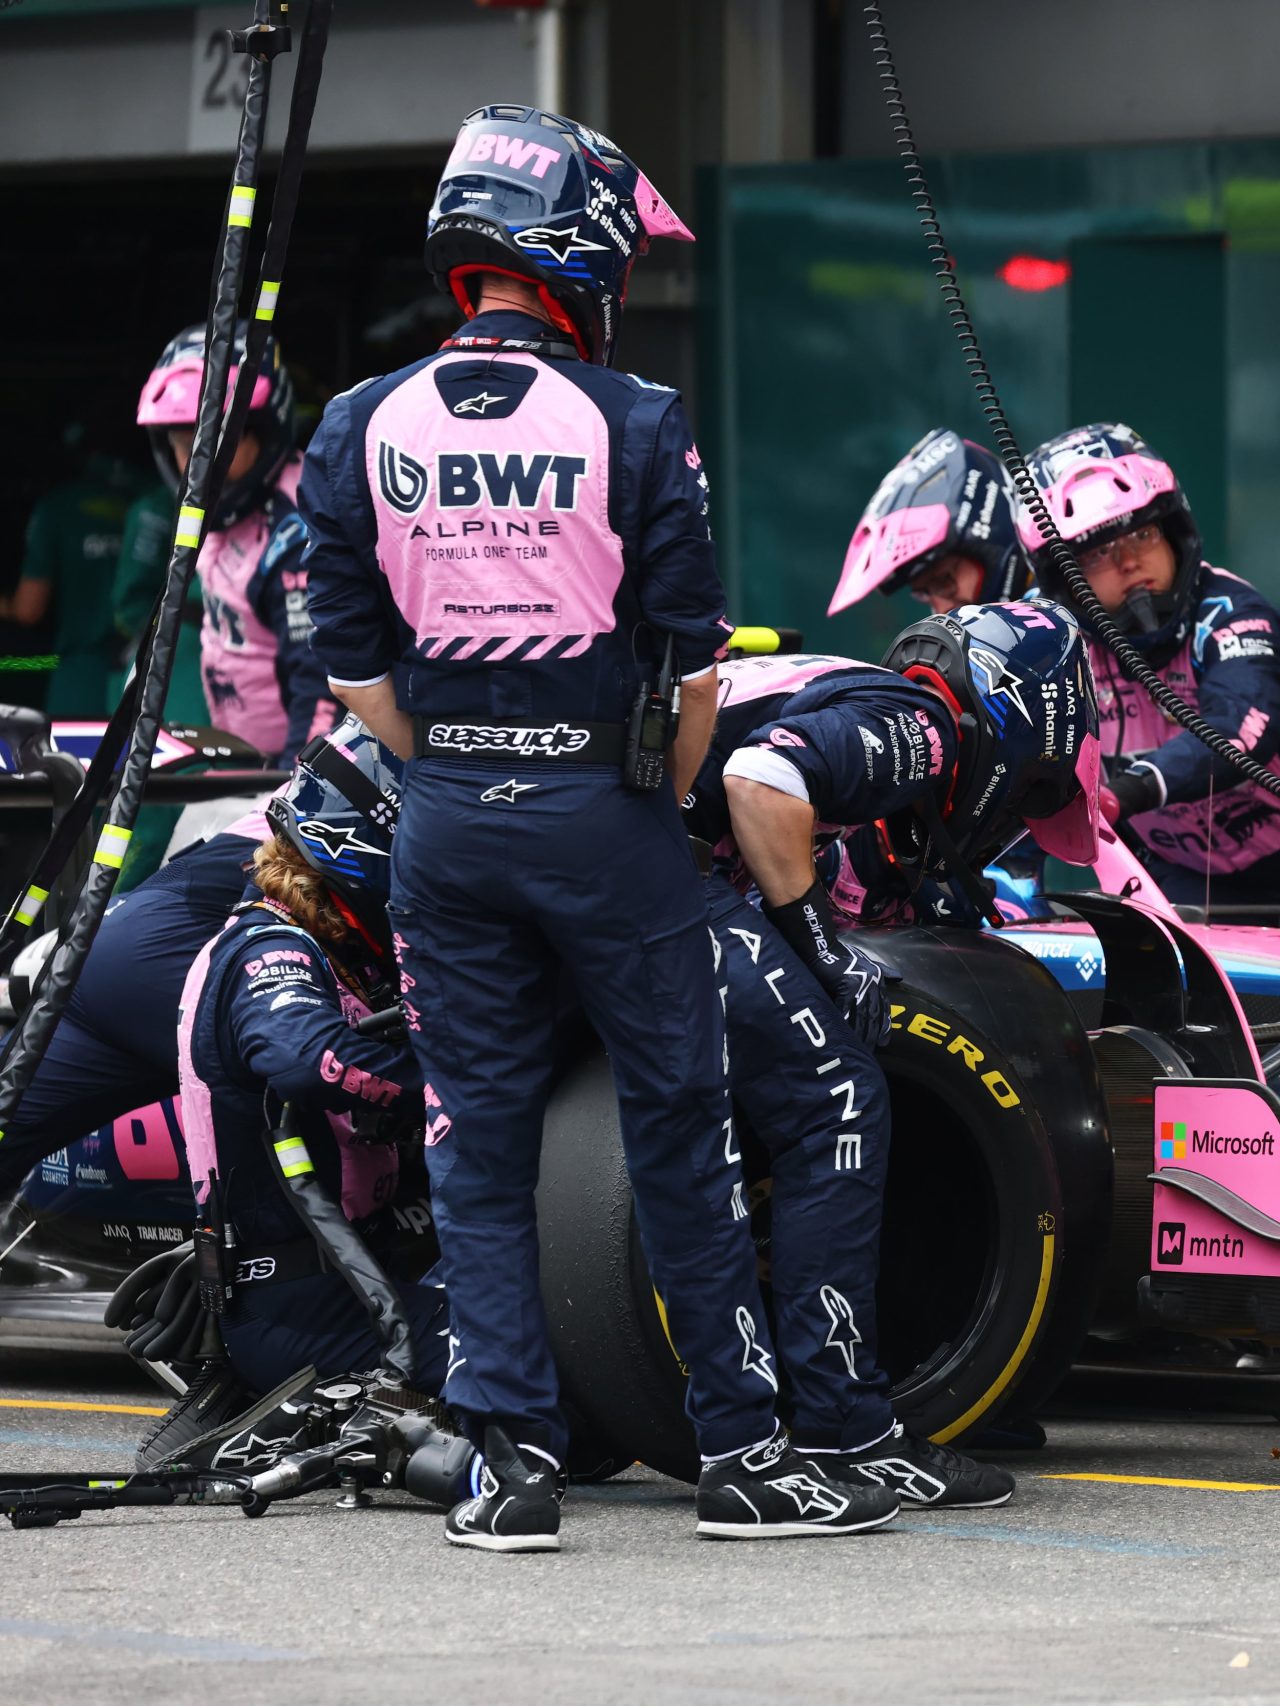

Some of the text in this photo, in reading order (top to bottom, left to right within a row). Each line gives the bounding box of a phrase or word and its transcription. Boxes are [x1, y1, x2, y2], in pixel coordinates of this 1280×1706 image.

[468, 133, 561, 179] BWT
[599, 214, 632, 258] shamir
[434, 451, 589, 512] BWT
[410, 520, 561, 541] ALPINE
[425, 547, 478, 561] FORMULA
[515, 546, 548, 560] TEAM
[1001, 602, 1057, 631] WT
[1065, 677, 1077, 717] JAAQ
[1099, 703, 1138, 722] MC
[428, 723, 591, 756] alpinestars
[1045, 701, 1058, 756] shamir
[888, 724, 901, 786] businessolver
[921, 723, 944, 778] BWT
[972, 774, 1000, 818] BINANCE
[1149, 814, 1221, 852] eni
[262, 950, 312, 967] BWT
[728, 926, 861, 1172] ALPINE
[341, 1064, 403, 1108] BWT
[1192, 1130, 1275, 1155] Microsoft
[41, 1172, 69, 1187] COSMETICS
[103, 1223, 132, 1243] JAAQ
[158, 1226, 184, 1242] RACER
[1189, 1234, 1244, 1258] mntn
